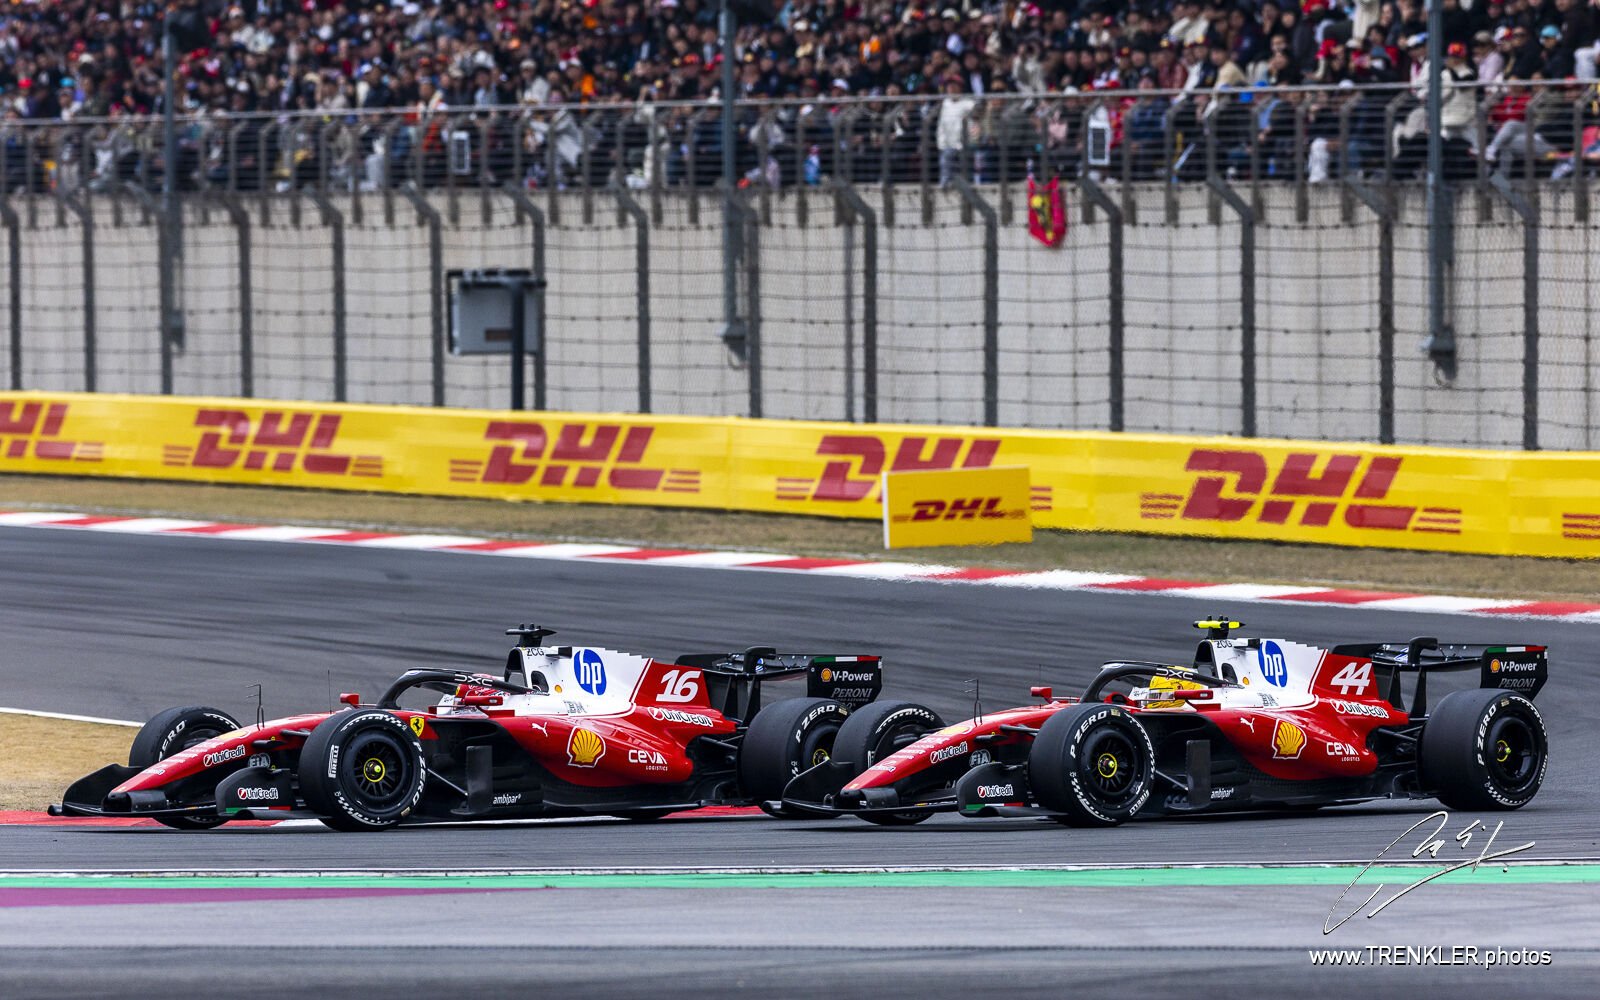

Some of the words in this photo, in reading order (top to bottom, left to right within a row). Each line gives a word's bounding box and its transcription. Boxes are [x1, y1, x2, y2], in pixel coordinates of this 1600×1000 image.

[0, 402, 76, 459] HL
[192, 409, 351, 475] DHL
[482, 421, 664, 490] DHL
[1181, 449, 1418, 530] DHL
[912, 497, 1005, 521] DHL
[577, 649, 603, 695] hp
[832, 671, 873, 682] V-Power
[1261, 641, 1284, 687] hp
[1330, 662, 1372, 695] 44
[1500, 661, 1537, 672] V-Power
[655, 669, 702, 702] 16
[830, 687, 872, 698] PERONI
[1498, 678, 1536, 688] PERONI
[801, 704, 835, 730] ZERO
[1477, 703, 1496, 751] ZERO
[412, 741, 422, 752] P
[1069, 744, 1076, 759] P
[1074, 710, 1107, 744] ZERO
[212, 744, 245, 764] UniCredit
[327, 744, 340, 778] PIRELLI
[938, 741, 968, 761] UniCredit
[1477, 753, 1485, 766] P
[246, 787, 279, 800] UniCredit
[413, 755, 426, 806] ZERO
[985, 784, 1013, 797] UniCredit
